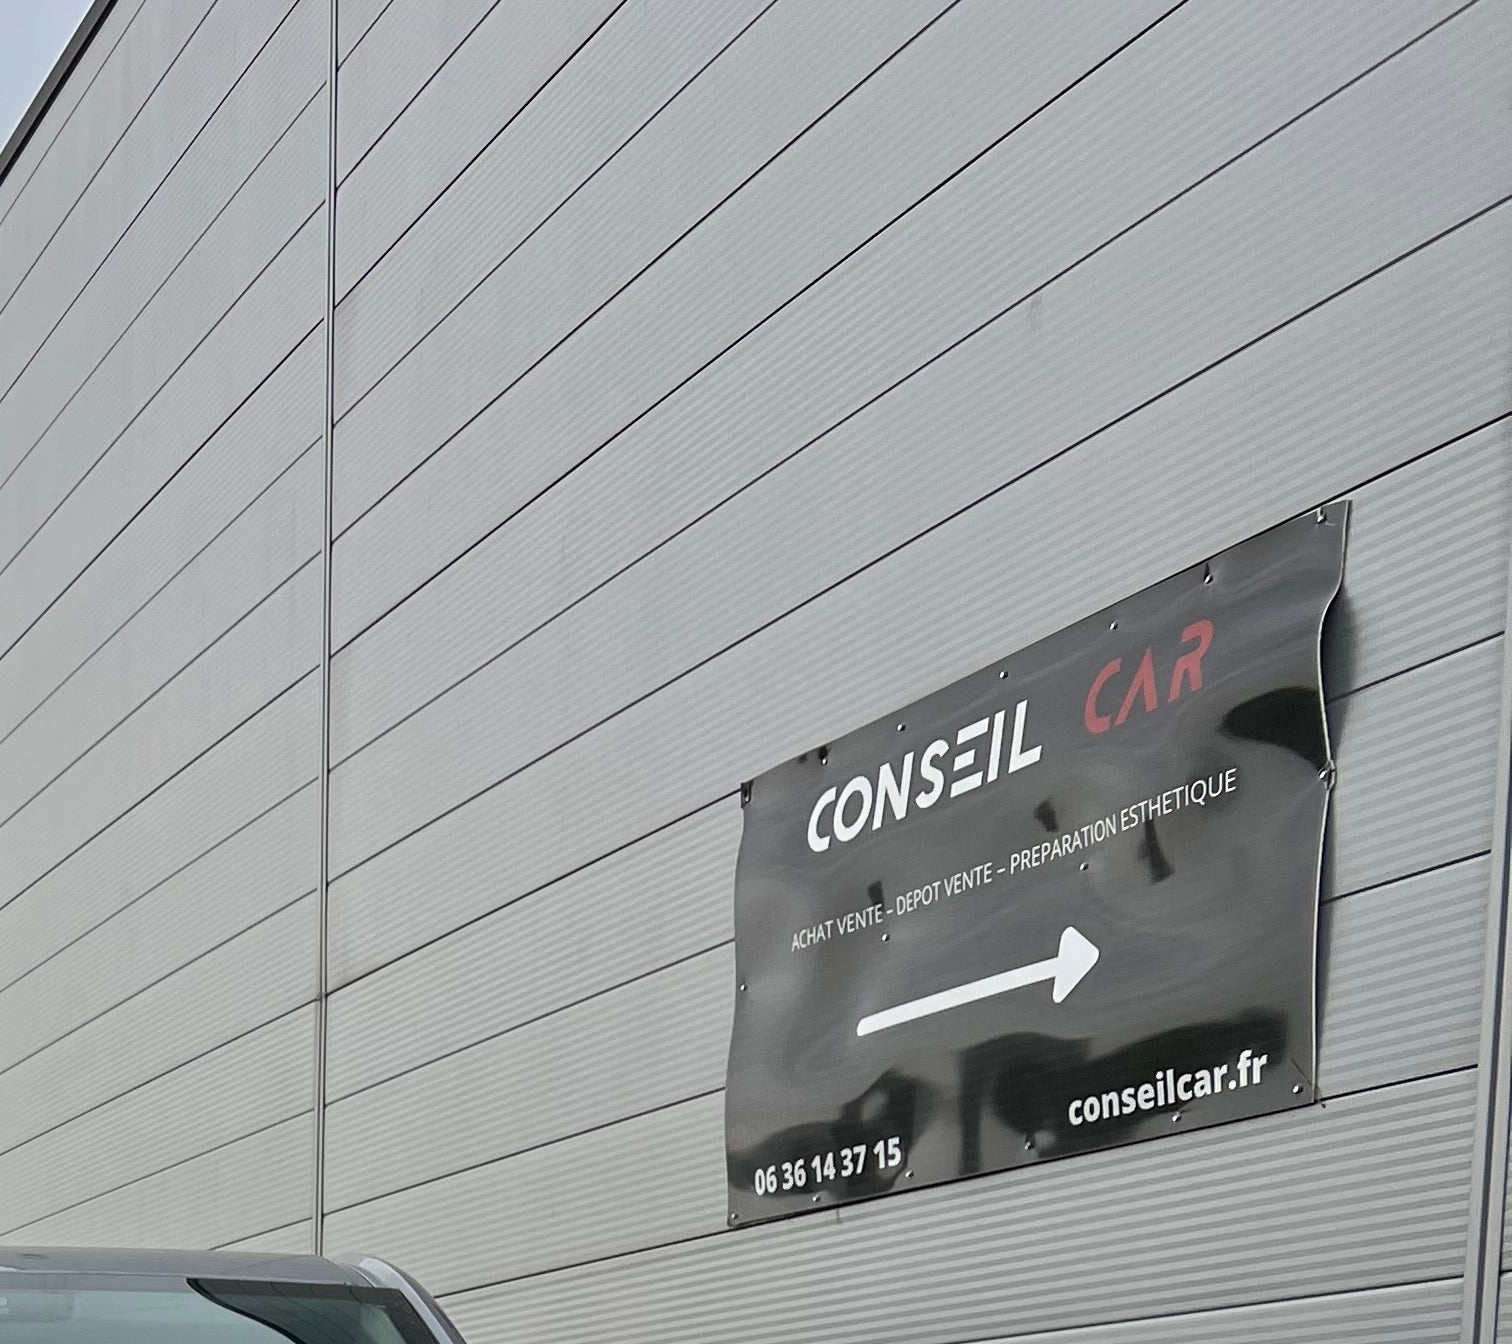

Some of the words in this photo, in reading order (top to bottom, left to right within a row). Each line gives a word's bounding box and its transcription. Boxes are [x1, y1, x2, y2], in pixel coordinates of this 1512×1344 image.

[806, 699, 1043, 853] CONSEIL
[1084, 619, 1215, 735] CAR
[791, 919, 834, 952] ACHAT
[836, 903, 884, 935] VENTE
[896, 881, 941, 916] DEPOT
[943, 862, 993, 897] VENTE
[1010, 813, 1117, 875] PREPARATION
[1121, 767, 1237, 833] ESTHETIQUE
[1068, 1049, 1268, 1126] conseilcar.fr
[754, 1165, 778, 1196] 06
[781, 1158, 807, 1190] 36
[811, 1151, 836, 1183] 14
[840, 1144, 867, 1177] 37
[873, 1136, 902, 1169] 15
